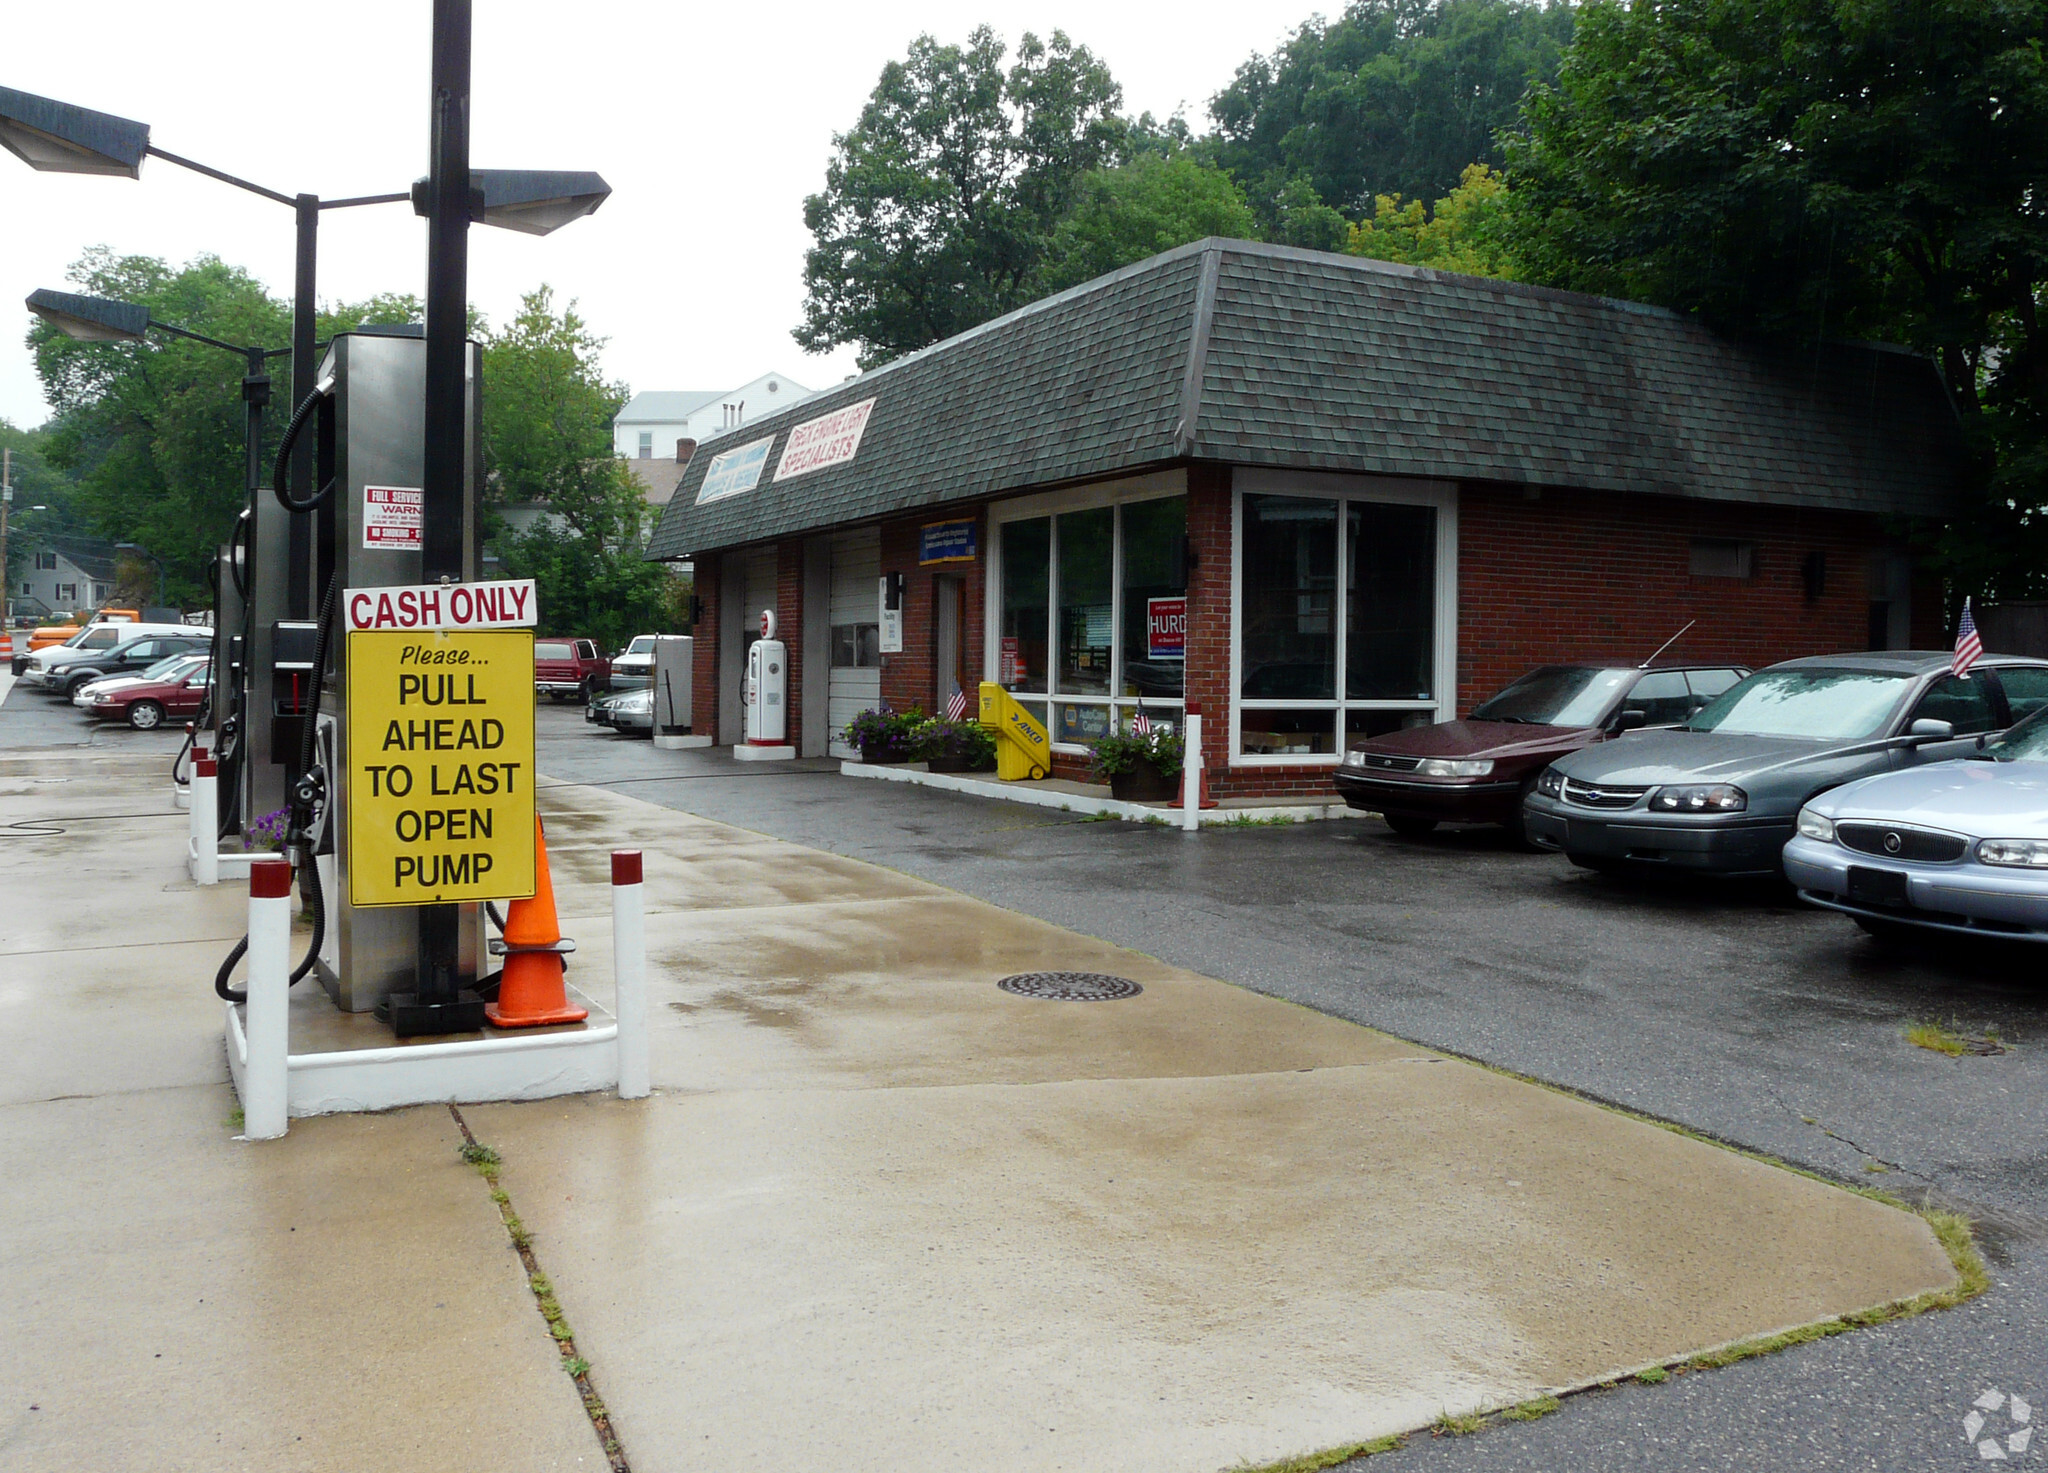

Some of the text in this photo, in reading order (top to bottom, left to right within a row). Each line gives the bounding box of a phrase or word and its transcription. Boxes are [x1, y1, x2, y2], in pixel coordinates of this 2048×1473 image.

[812, 412, 846, 443] ENGINE
[841, 403, 872, 432] LIGHT
[780, 434, 855, 475] SPECIALISTS
[371, 490, 389, 502] FULL
[351, 586, 529, 629] CASH ONLY
[400, 645, 489, 665] Please...
[399, 674, 487, 706] PULL
[382, 718, 504, 751] AHEAD
[1017, 722, 1044, 744] ANCO
[1082, 720, 1103, 732] Center
[364, 762, 521, 797] TO LAST
[395, 808, 492, 842] OPEN
[395, 853, 493, 888] PUMP
